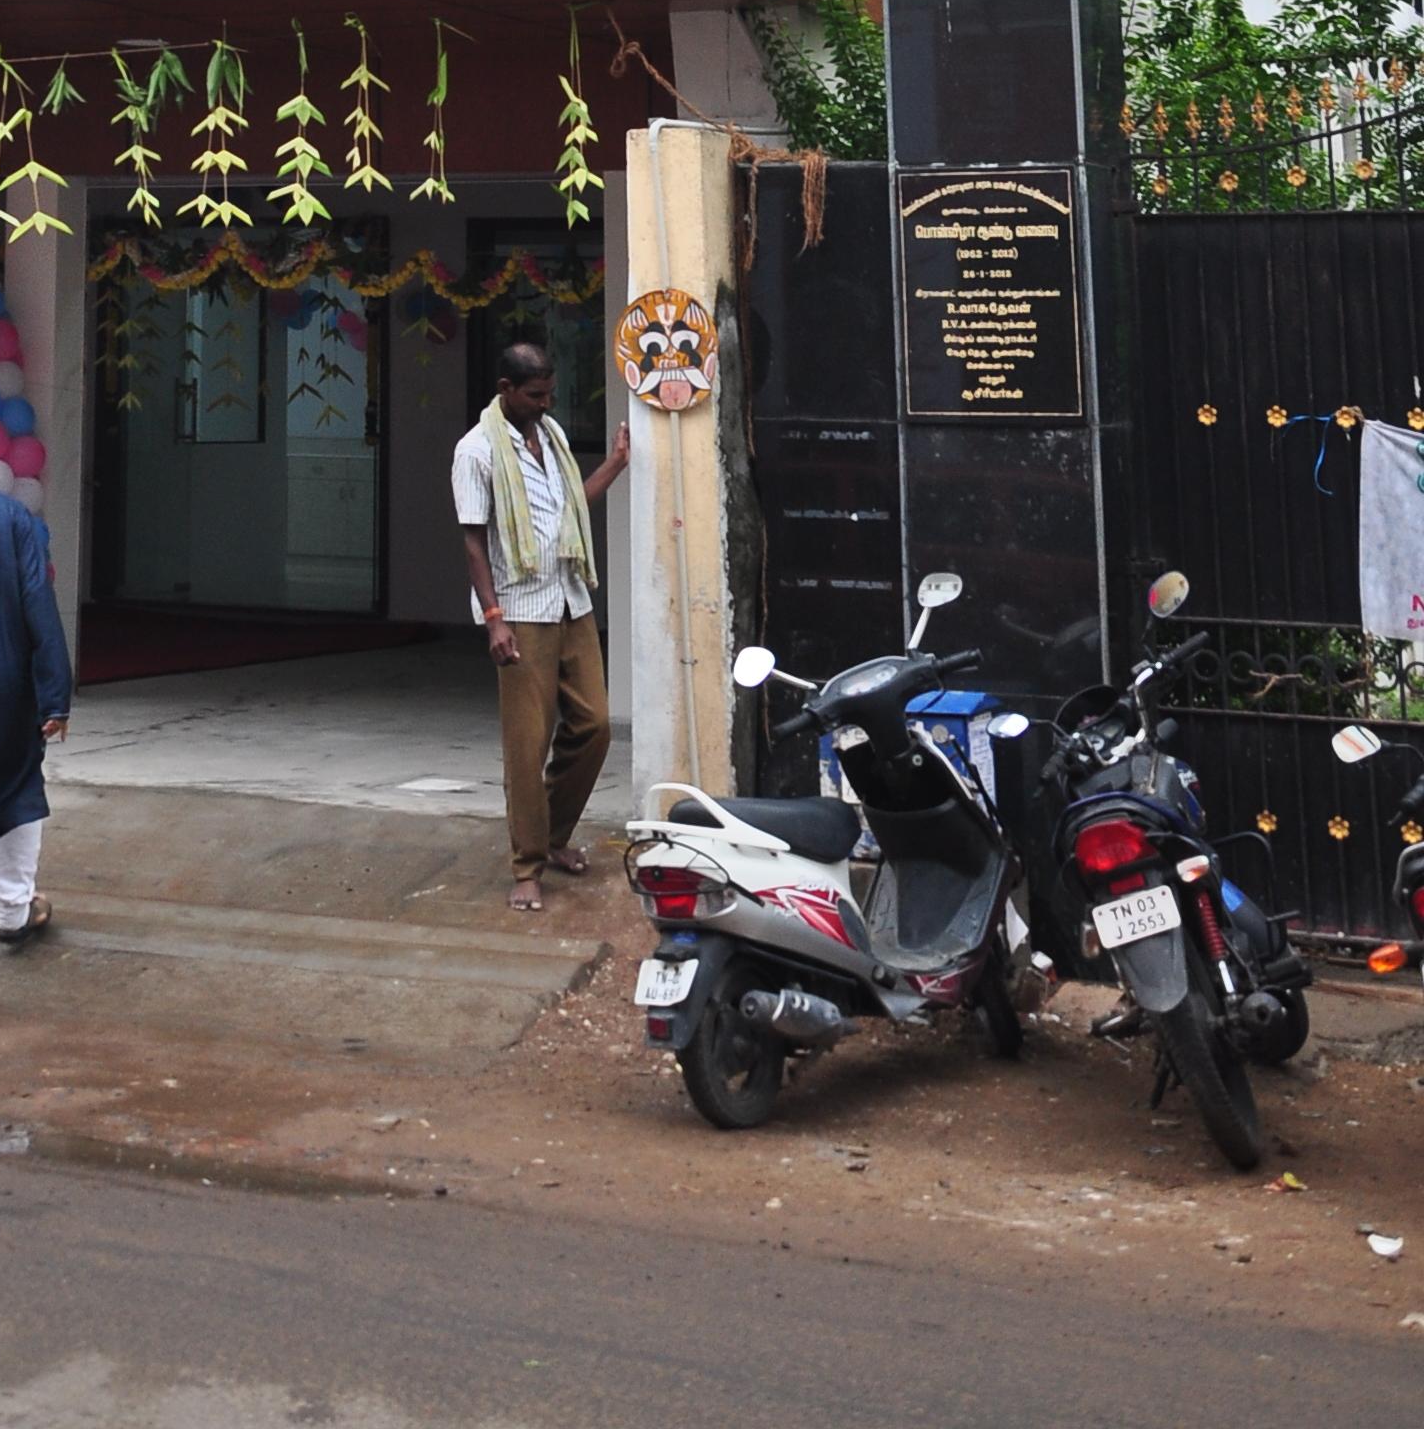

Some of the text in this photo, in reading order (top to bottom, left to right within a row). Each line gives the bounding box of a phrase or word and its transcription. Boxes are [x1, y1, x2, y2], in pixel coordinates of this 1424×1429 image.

[1109, 895, 1157, 921] TN 03
[1116, 912, 1166, 940] J 2553
